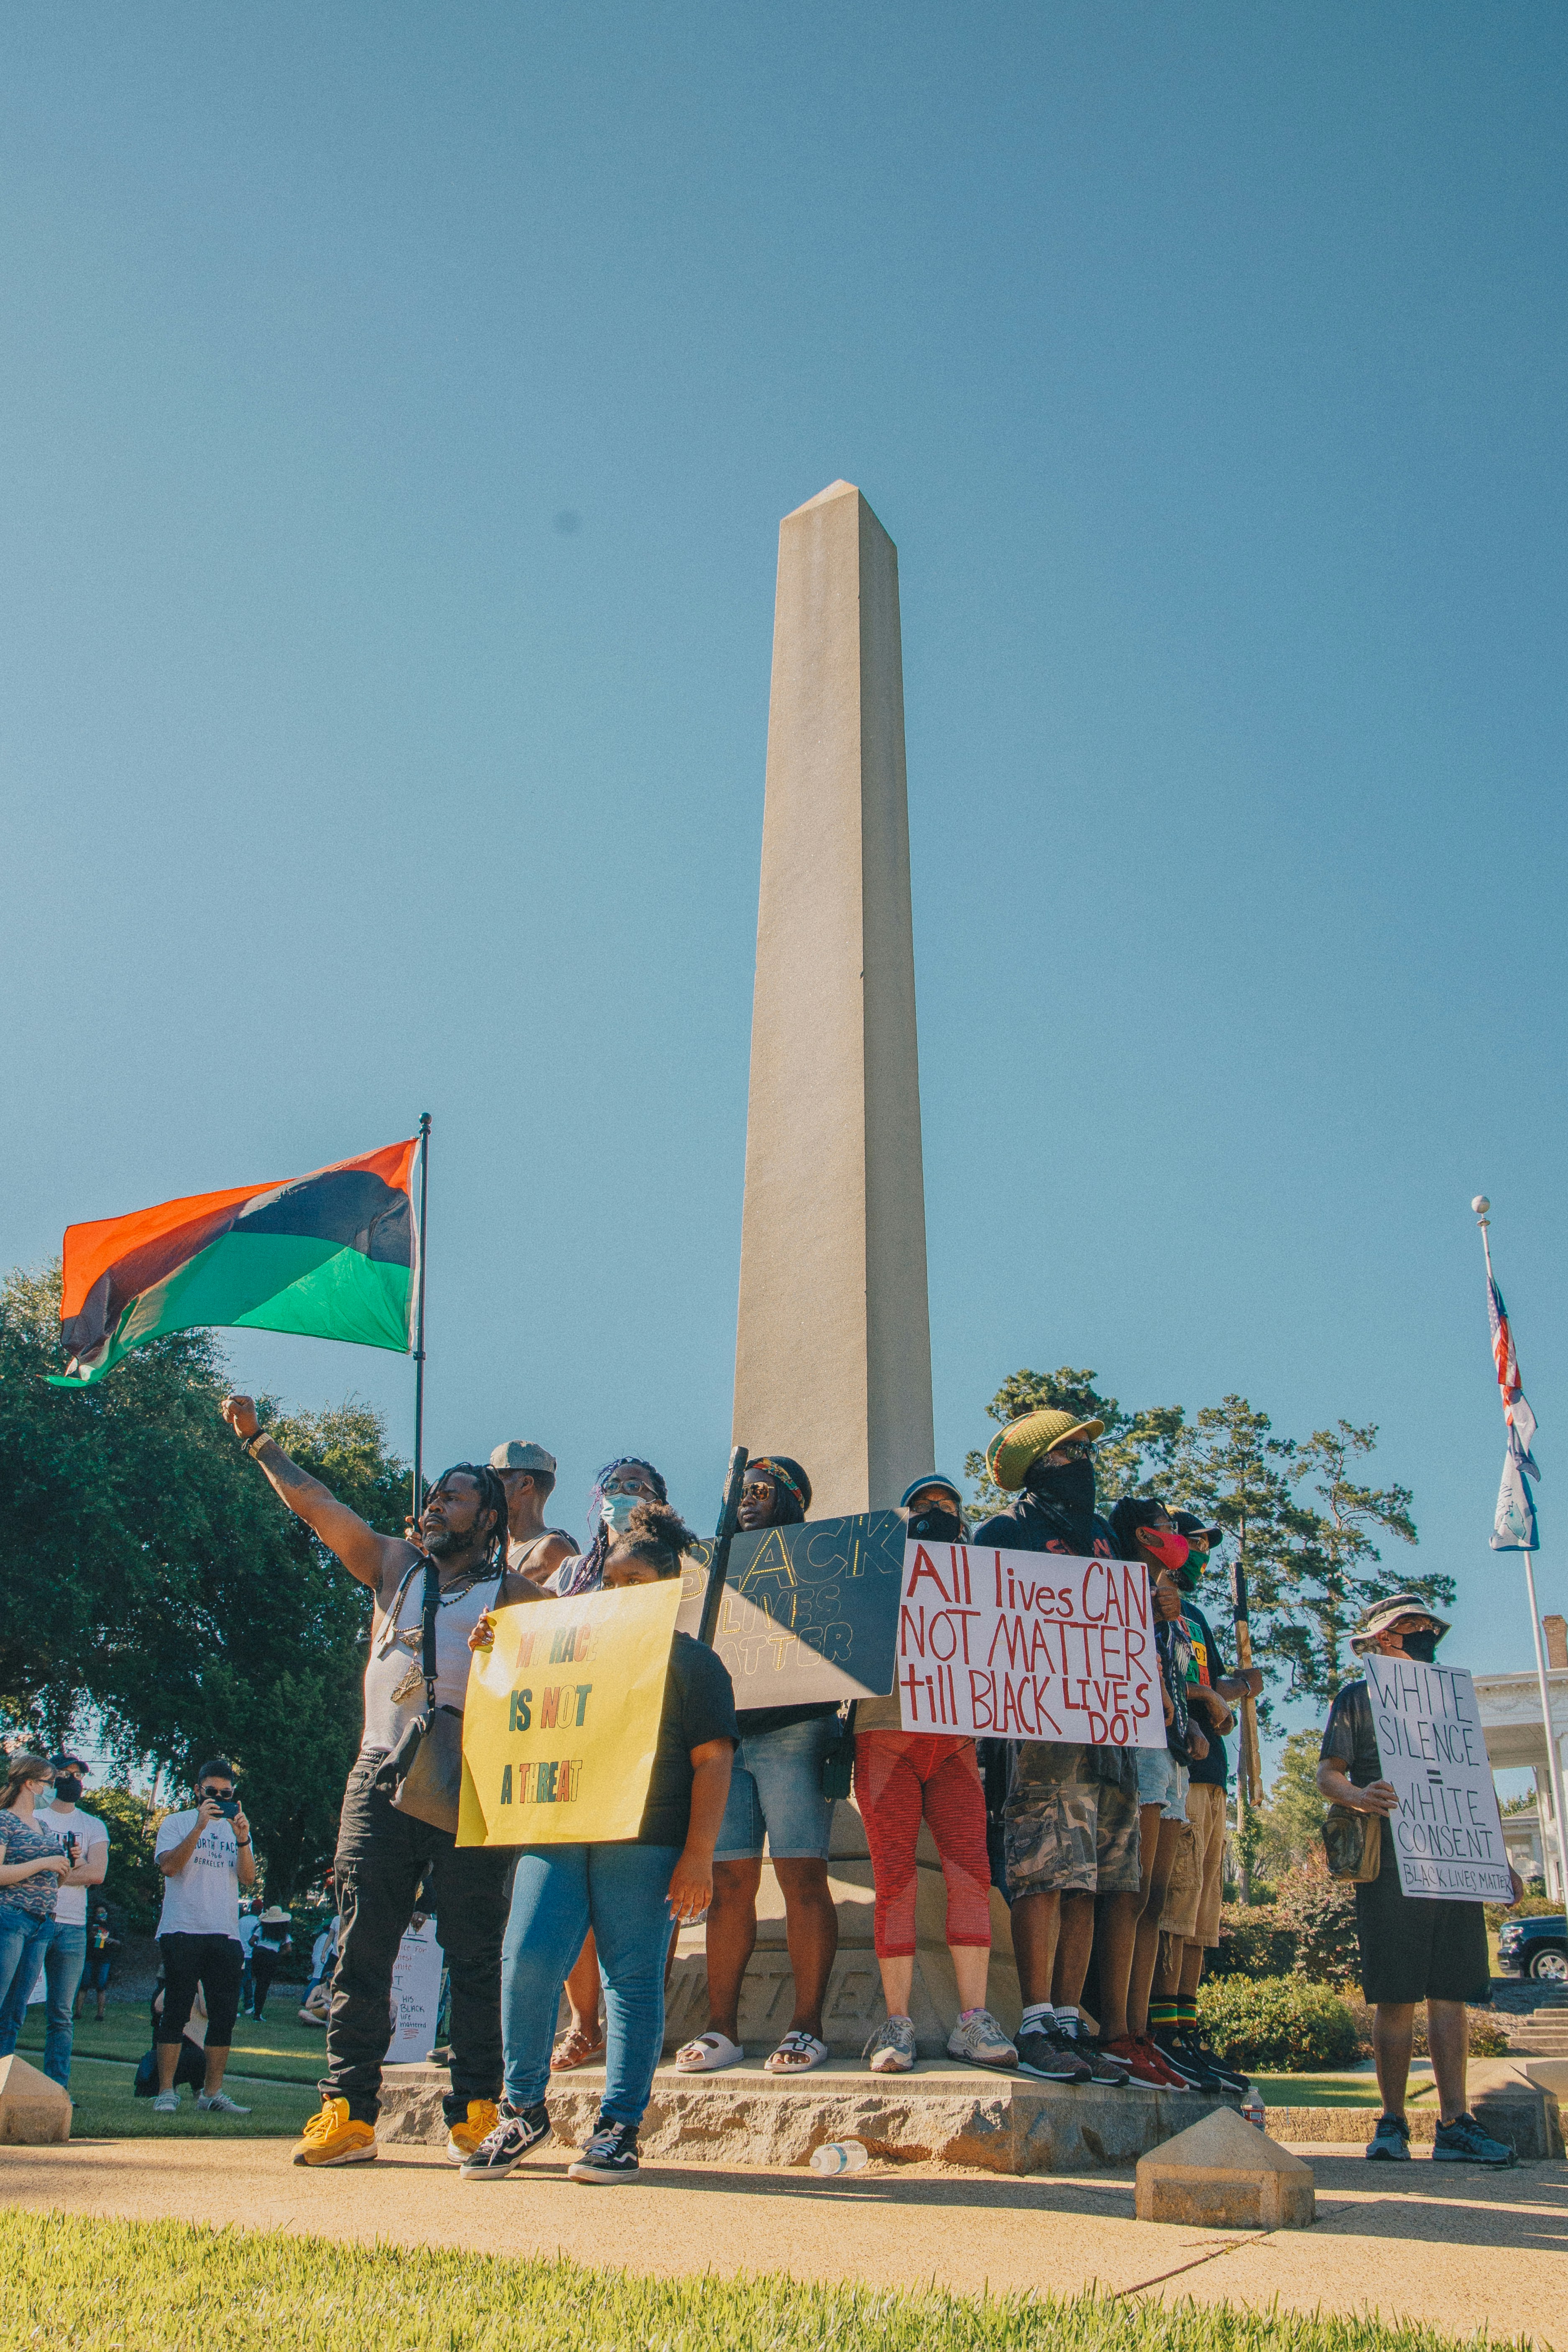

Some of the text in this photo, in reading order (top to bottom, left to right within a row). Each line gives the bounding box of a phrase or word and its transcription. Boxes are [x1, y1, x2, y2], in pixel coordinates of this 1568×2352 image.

[681, 1507, 908, 1602] BACK
[907, 1543, 1147, 1630] All lives CAN
[718, 1585, 841, 1635] LIVES
[516, 1623, 602, 1668] MY RACE
[719, 1622, 853, 1677] ATTER
[901, 1605, 1153, 1682] NOT MATTER
[509, 1684, 592, 1731] IS NOT
[900, 1663, 1151, 1735] till BLACK LIVES
[1368, 1658, 1473, 1724] WHITE
[1087, 1711, 1139, 1745] DO!
[1379, 1715, 1480, 1767] SILENCE
[501, 1760, 583, 1805] A THREAT
[1390, 1781, 1486, 1826] WHITE
[194, 1857, 225, 1868] BERKELEY
[195, 1838, 215, 1851] ORTH
[1397, 1821, 1493, 1859] CONSENT
[1403, 1863, 1514, 1896] BLACK LIVES MATTER
[400, 2004, 425, 2012] BLACK
